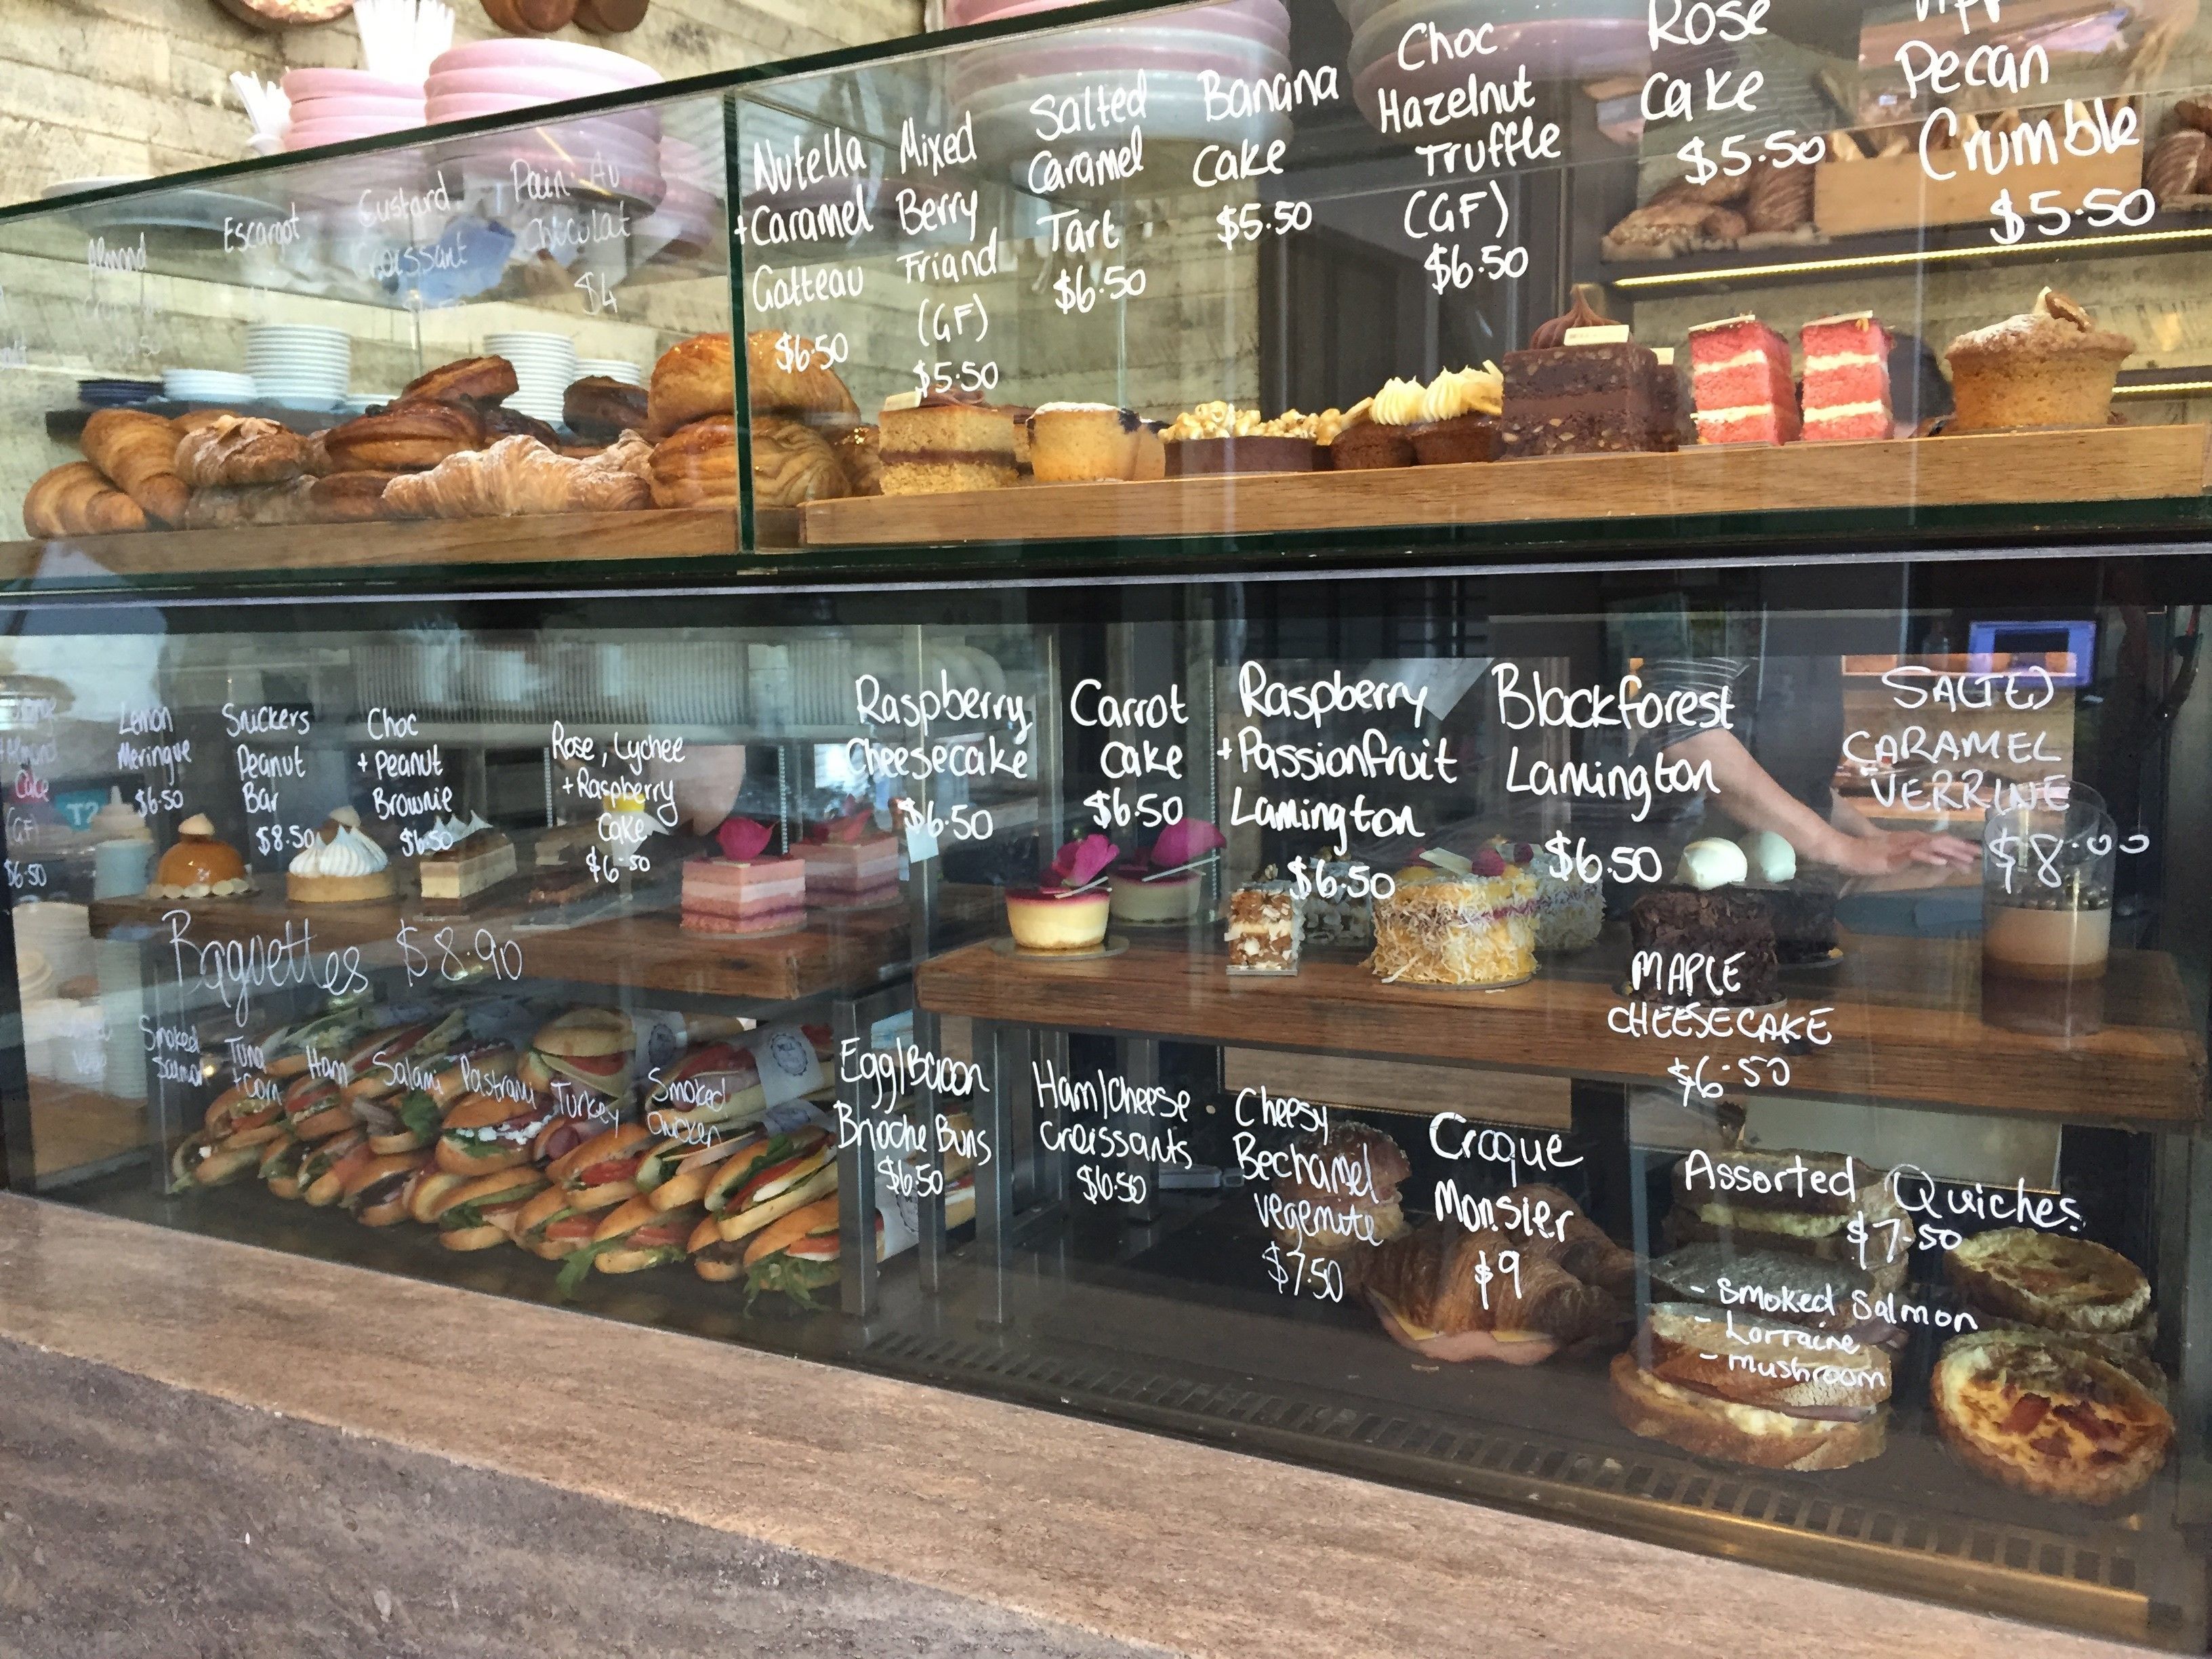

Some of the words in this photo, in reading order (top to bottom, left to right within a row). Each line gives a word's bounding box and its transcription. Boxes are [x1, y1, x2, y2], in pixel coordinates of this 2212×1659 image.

[1398, 22, 1498, 70] Choc
[1647, 0, 1769, 51] Rose
[1197, 66, 1338, 122] Banana
[1895, 39, 2049, 100] Pecan
[1029, 69, 1147, 141] Salted
[1377, 64, 1535, 133] Hazelnut
[754, 127, 867, 194] Nutella
[901, 110, 977, 175] Mixed
[1028, 125, 1144, 194] Caramel
[1415, 115, 1561, 176] Truffle
[1675, 129, 1826, 186] $5.50
[1919, 98, 2141, 182] Crumble
[510, 159, 571, 203] Pain
[895, 188, 978, 241] Berry
[1036, 209, 1119, 253] Tart
[1216, 201, 1312, 251] $5.50
[1404, 180, 1509, 239] (GF)
[1989, 187, 2156, 246] $5.50
[897, 227, 997, 283] Friand
[1423, 243, 1528, 295] $6.50
[575, 272, 617, 315] $4
[1053, 268, 1146, 313] $6.50
[918, 294, 988, 346] (GF)
[775, 332, 848, 373] $6.50
[912, 361, 999, 396] $5.50
[119, 701, 173, 735] Lemon
[855, 669, 1033, 744] Raspberry
[1071, 678, 1189, 729] Carrot
[1238, 660, 1427, 727] Raspberry
[222, 703, 310, 737] Snickers
[368, 708, 419, 739] Choc
[1842, 726, 2062, 764] CARAMEL
[117, 739, 192, 786] Meringue
[237, 744, 306, 781] Peanut
[375, 744, 443, 780] Peanut
[615, 732, 685, 775] Lychee
[846, 736, 1027, 780] Cheesecake
[135, 786, 184, 819] $6.50
[242, 781, 279, 813] Bar
[372, 786, 453, 819] Brownie
[1083, 787, 1183, 830] $6.50
[1507, 747, 1721, 823] Lamington
[1870, 769, 2070, 815] VERRINE
[255, 824, 314, 856] $8.50
[898, 798, 994, 840] $6.50
[1232, 787, 1425, 854] Lamington
[586, 846, 650, 883] $6.50
[1288, 855, 1395, 901] $6.50
[1545, 830, 1663, 884] $6.50
[1989, 827, 2150, 894] $8.00
[162, 909, 369, 1027] Baguettes
[396, 918, 523, 987] $8.90
[1631, 950, 1746, 997] MAPLE
[138, 1015, 201, 1053] Smoked
[1607, 1002, 1835, 1045] CHEESECAKE
[306, 1045, 348, 1087] Ham
[373, 1050, 444, 1095] Salami
[648, 1067, 726, 1113] Smoked
[1667, 1055, 1790, 1107] $6.50
[551, 1082, 619, 1138] Turkey
[834, 1101, 926, 1153] Brioche
[935, 1114, 991, 1166] Buns
[1235, 1086, 1328, 1146] Cheesy
[1040, 1122, 1193, 1169] Croissants
[1232, 1132, 1378, 1204] Bechamel
[1429, 1112, 1584, 1187] Croque
[878, 1155, 943, 1197] $6.50
[1077, 1165, 1147, 1205] $6.50
[1685, 1149, 1857, 1203] Assorted
[1884, 1163, 2086, 1231] Quiches
[1435, 1179, 1573, 1243] Monsier
[1847, 1210, 1963, 1270] $7.50
[1262, 1241, 1343, 1303] $7.50
[1475, 1250, 1522, 1309] $9
[1727, 1311, 1861, 1354] Lorraine
[1852, 1289, 1979, 1332] Salmon
